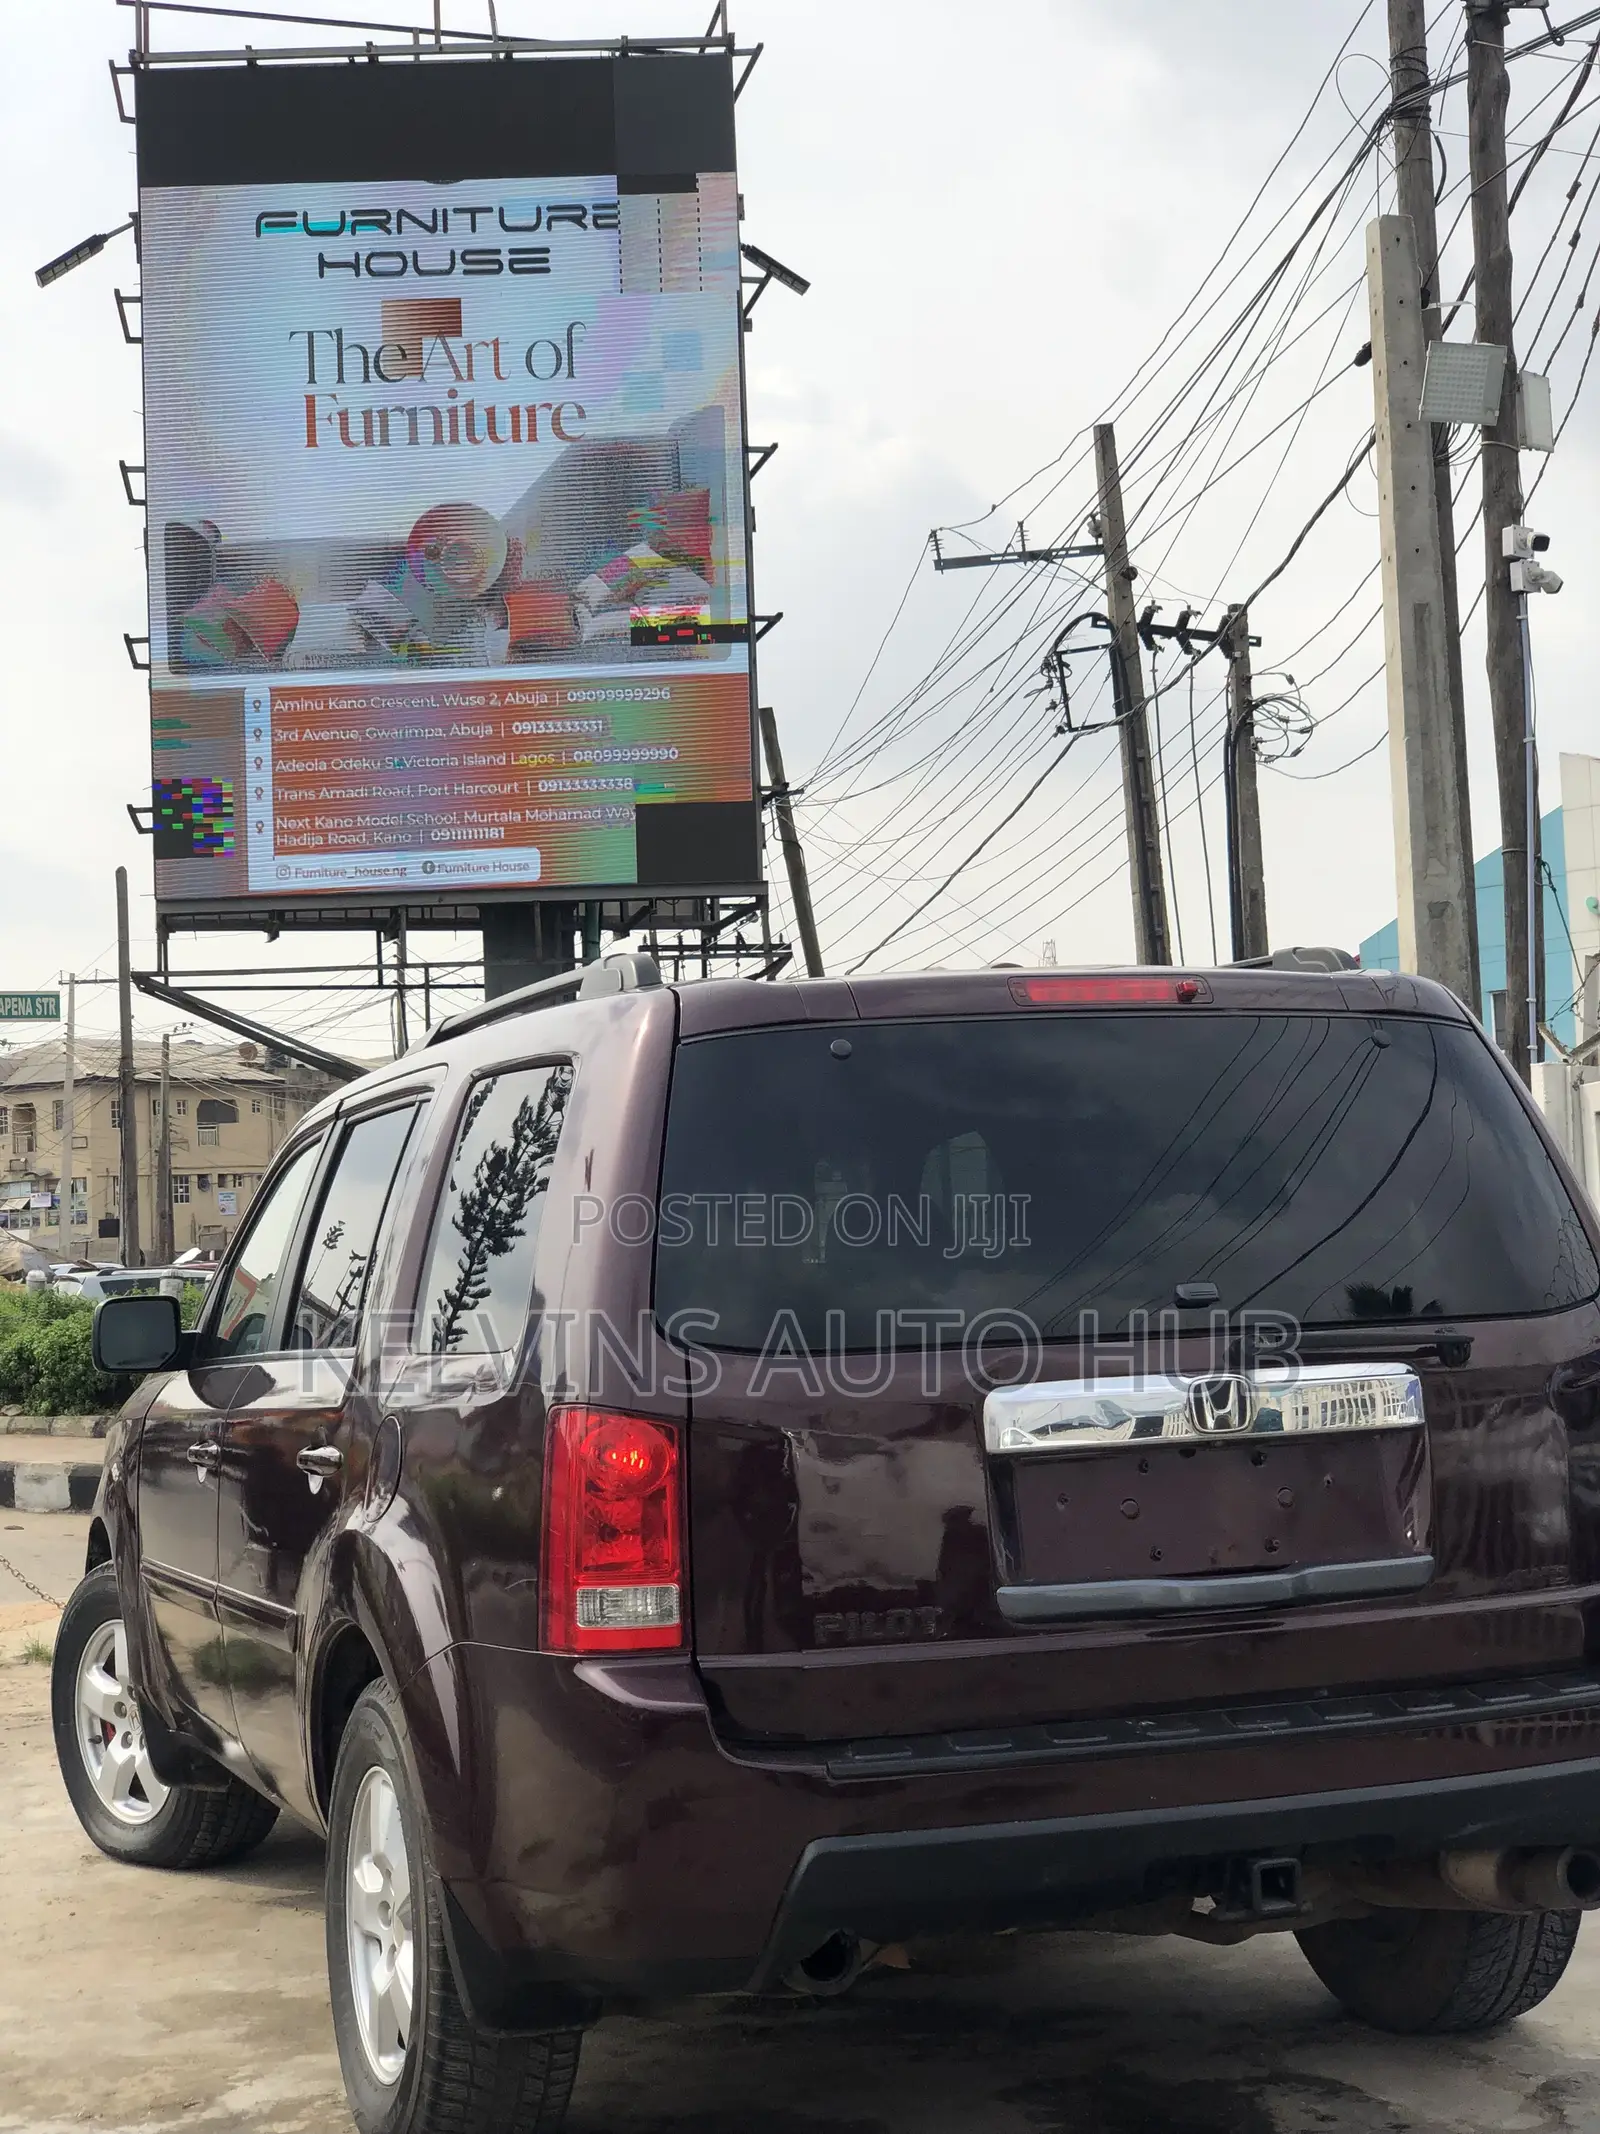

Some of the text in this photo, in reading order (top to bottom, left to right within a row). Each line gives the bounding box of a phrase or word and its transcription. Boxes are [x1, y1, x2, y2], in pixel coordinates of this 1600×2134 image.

[255, 203, 619, 237] FURNITURE
[318, 247, 552, 279] HOUSE
[289, 321, 587, 384] The Art of
[303, 388, 587, 449] Furniture
[273, 697, 324, 713] Aminu
[328, 697, 366, 710] Kano
[443, 692, 486, 707] Wuse
[504, 691, 548, 707] Abuja
[273, 728, 298, 742] 3rd
[302, 727, 362, 742] Avenue,
[450, 721, 493, 738] Abuja
[275, 757, 327, 773] Adeola
[331, 757, 381, 772] Odeku
[463, 751, 506, 767] Island
[511, 751, 555, 768] Lagos
[275, 787, 316, 801] Trans
[319, 785, 368, 800] Amadi
[372, 784, 415, 799] Road,
[418, 783, 450, 797] Port
[454, 781, 519, 796] Harcourt
[276, 815, 311, 831] Next
[315, 814, 353, 829] Kano
[357, 812, 403, 828] Model
[464, 808, 521, 824] Murtala
[525, 806, 601, 822] Mohamad
[276, 832, 323, 848] Hadija
[327, 831, 370, 846] Road,
[373, 831, 412, 845] Kano
[437, 860, 530, 875] Furniture House
[35, 997, 57, 1016] STR
[814, 1606, 946, 1645] PILOT
